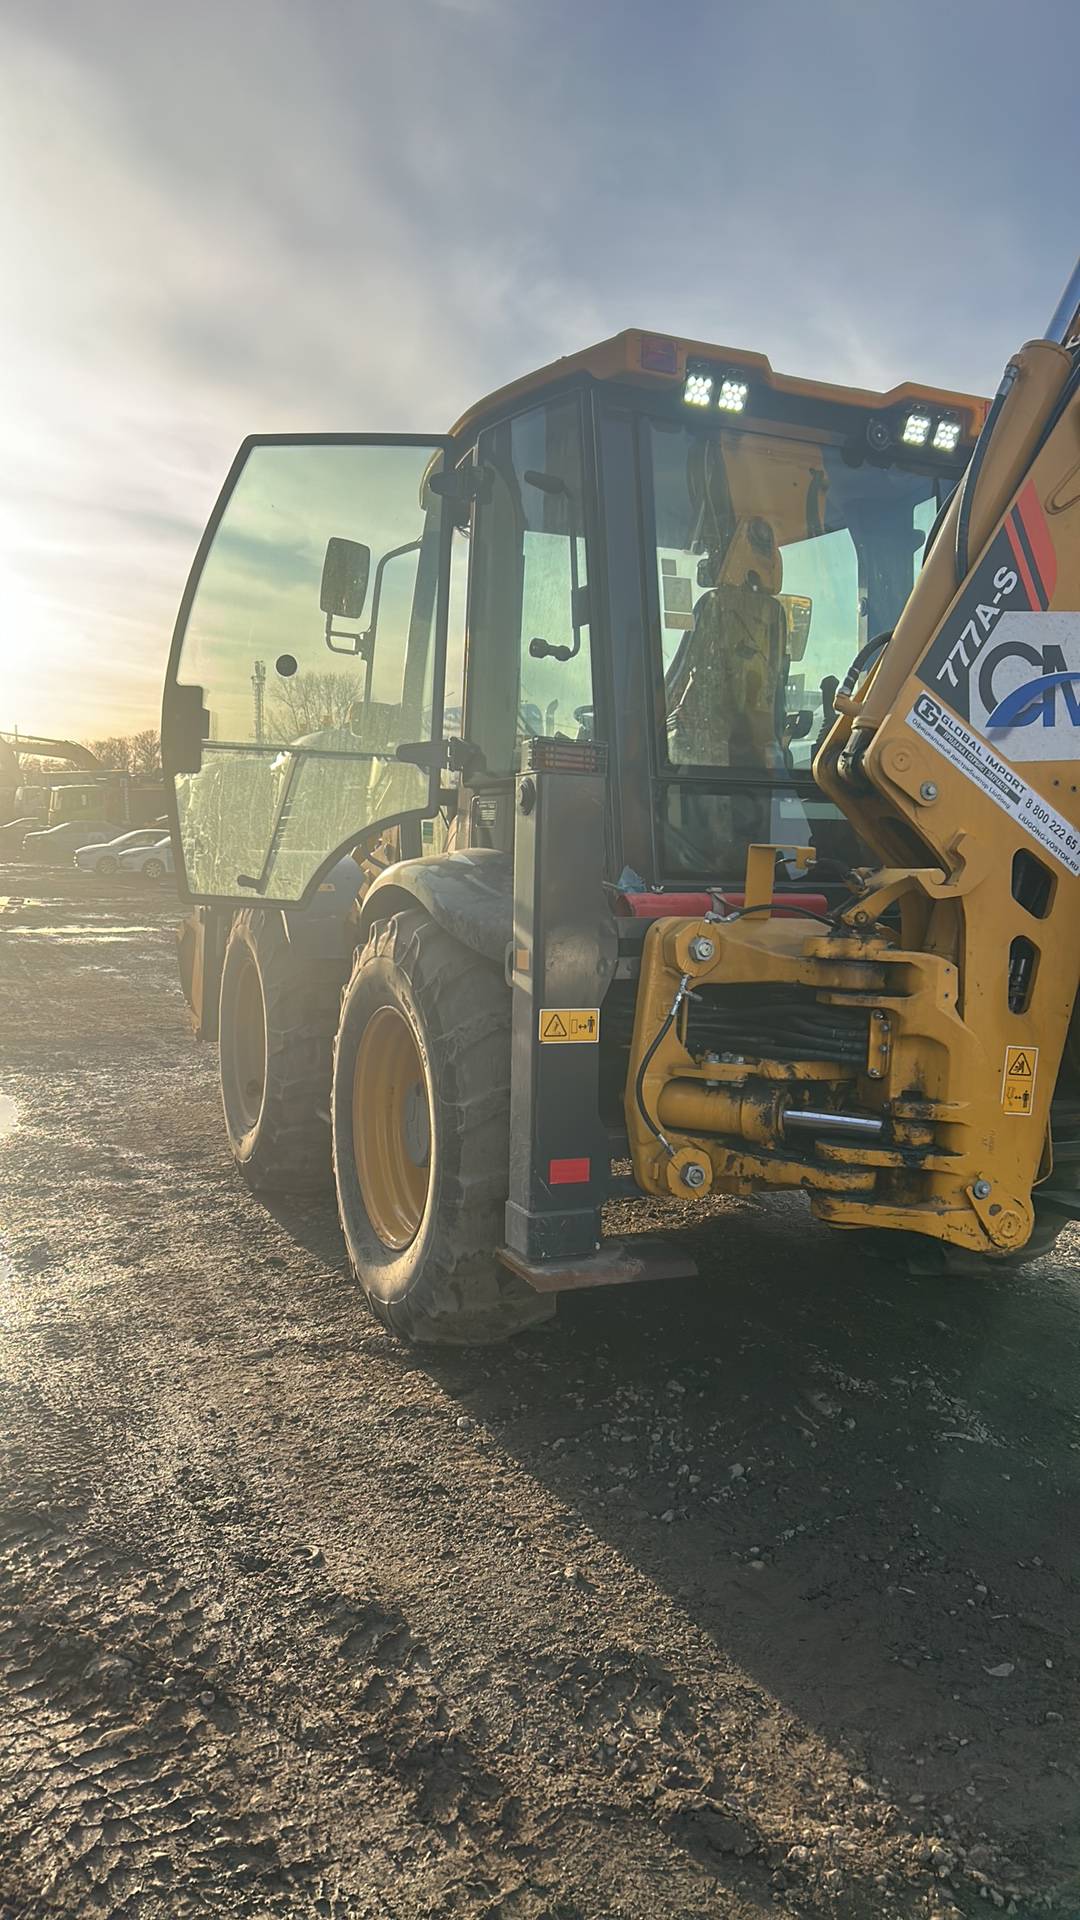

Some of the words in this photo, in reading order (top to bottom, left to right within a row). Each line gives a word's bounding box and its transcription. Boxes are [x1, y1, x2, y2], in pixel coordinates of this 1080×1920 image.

[936, 566, 1018, 687] 777A-S
[941, 715, 982, 757] GLOBAL
[986, 754, 1028, 794] IMPORT
[1025, 798, 1033, 809] 8
[1032, 804, 1050, 824] 800
[1049, 820, 1066, 840] 222
[1065, 835, 1078, 850] 65
